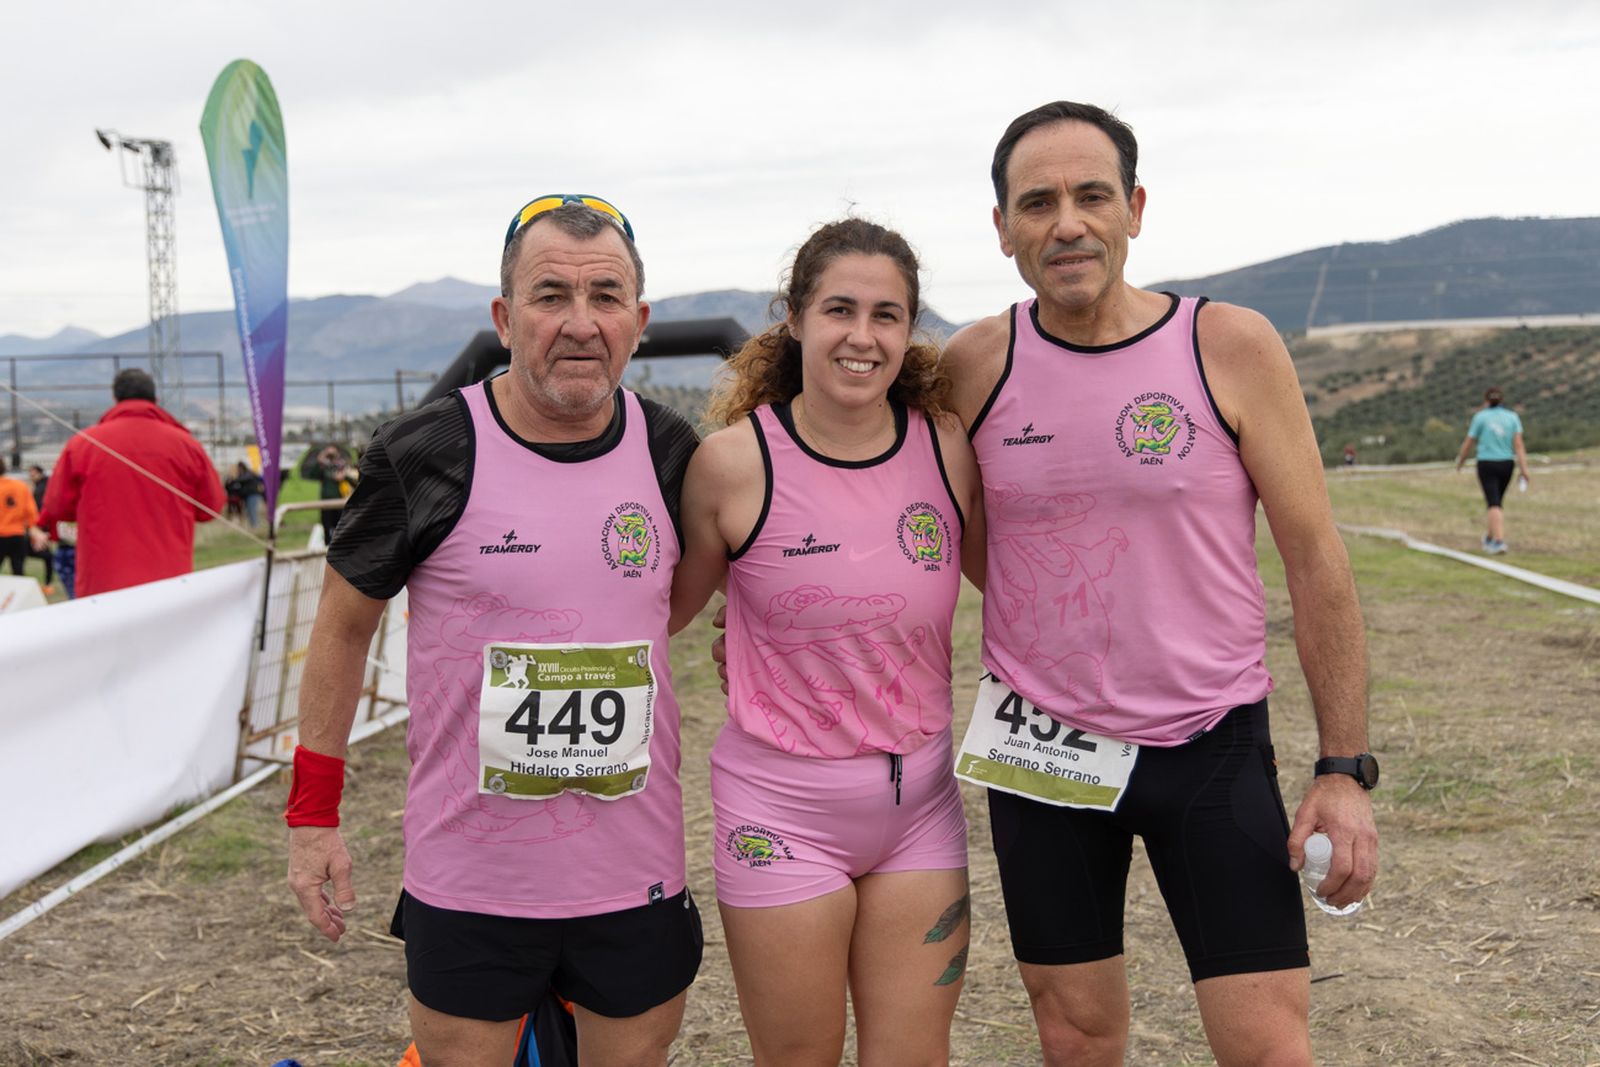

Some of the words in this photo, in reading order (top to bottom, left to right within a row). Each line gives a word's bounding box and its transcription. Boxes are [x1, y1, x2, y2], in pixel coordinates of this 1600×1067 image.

[1115, 403, 1134, 458] ASOCIACION
[1133, 392, 1185, 412] DEPORTIVA
[1177, 413, 1197, 460] MARATON
[1002, 434, 1055, 446] TEAMERGY
[601, 513, 619, 570] ASOCIACION
[615, 502, 653, 524] DEPORTIVA
[479, 544, 541, 554] TEAMERGY
[782, 543, 841, 557] TEAMERGY
[537, 662, 560, 673] XXVIII
[580, 664, 606, 672] Provincial
[537, 672, 573, 684] Campo
[584, 671, 616, 681] través
[641, 671, 655, 745] Discapacitado
[505, 690, 626, 745] 449
[526, 747, 559, 759] Jose
[561, 746, 608, 758] Manuel
[1003, 735, 1031, 750] Juan
[1032, 742, 1080, 762] Antonio
[1120, 741, 1132, 758] Ve
[511, 761, 570, 780] Hidalgo
[575, 761, 629, 777] Serrano
[987, 748, 1040, 772] Serrano
[1043, 761, 1101, 785] Serrano
